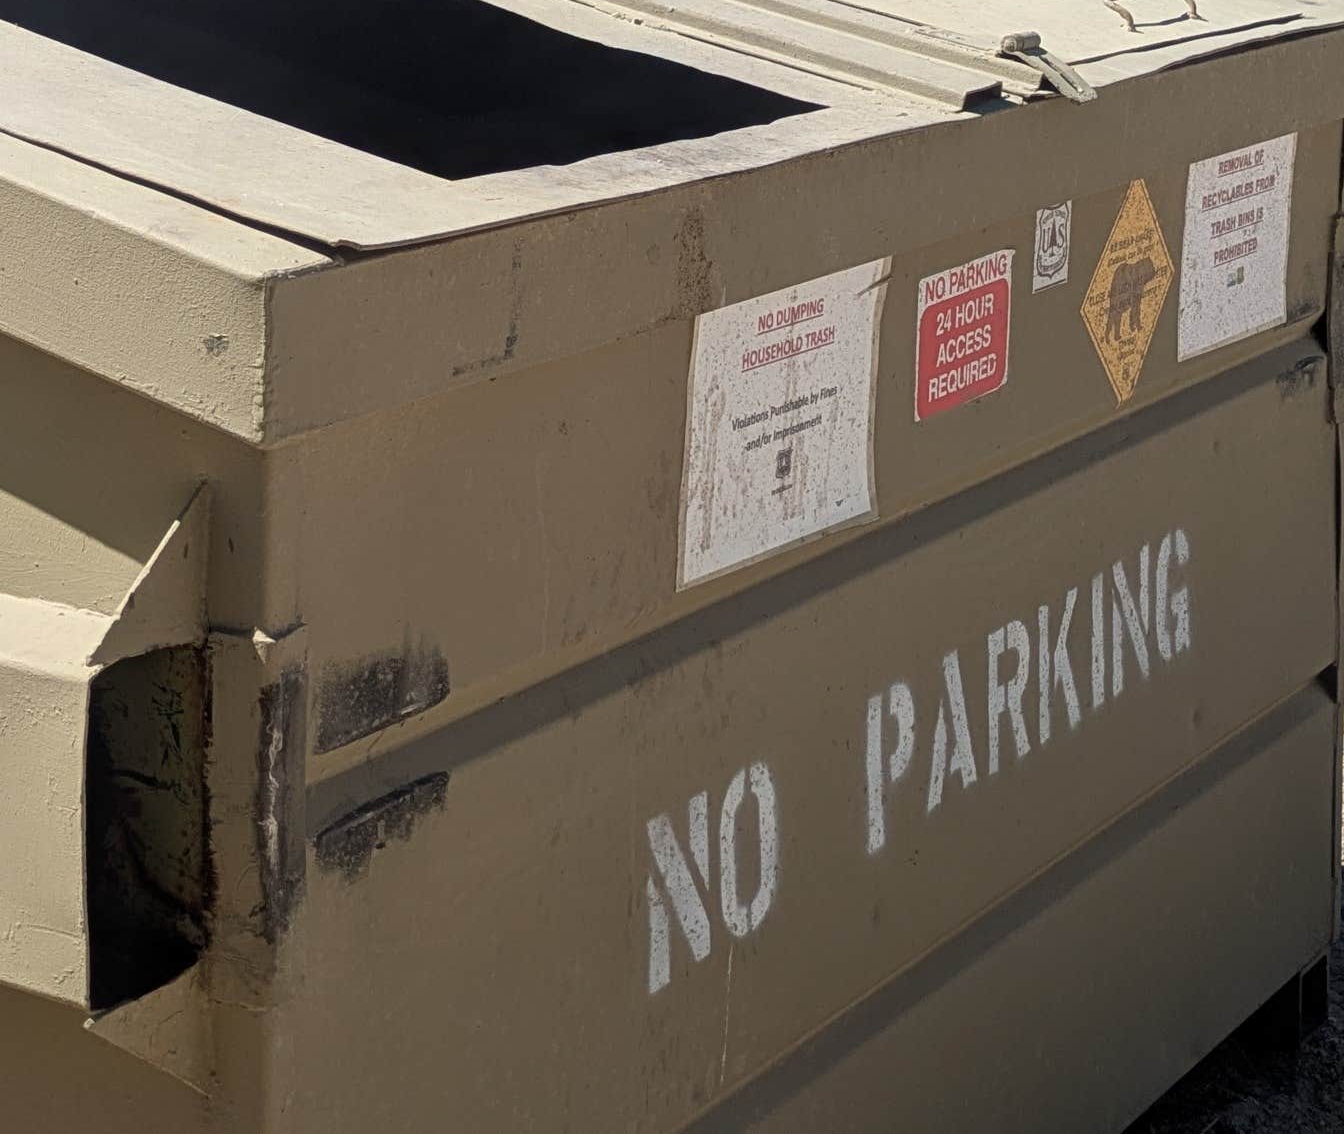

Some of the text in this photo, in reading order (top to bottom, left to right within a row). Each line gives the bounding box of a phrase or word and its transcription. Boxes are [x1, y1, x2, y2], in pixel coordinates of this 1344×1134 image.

[1218, 149, 1264, 175] REMOVAL OF
[1202, 174, 1275, 209] RECYCLABLES FROM
[1211, 206, 1264, 236] TRASH BINS IS
[1214, 237, 1257, 264] PROHIBITED
[925, 276, 945, 303] NO
[949, 254, 1007, 295] PARKING
[758, 298, 824, 332] NO DUMPING
[936, 293, 994, 336] 24 HOUR
[742, 325, 835, 369] HOUSEHOLD TRASH
[936, 324, 992, 368] ACCESS
[928, 353, 997, 402] REQUIRED
[731, 386, 837, 431] Violations Punishable by Fines
[746, 414, 822, 452] and/or Imprisonment
[646, 528, 1191, 995] NO PARKING
